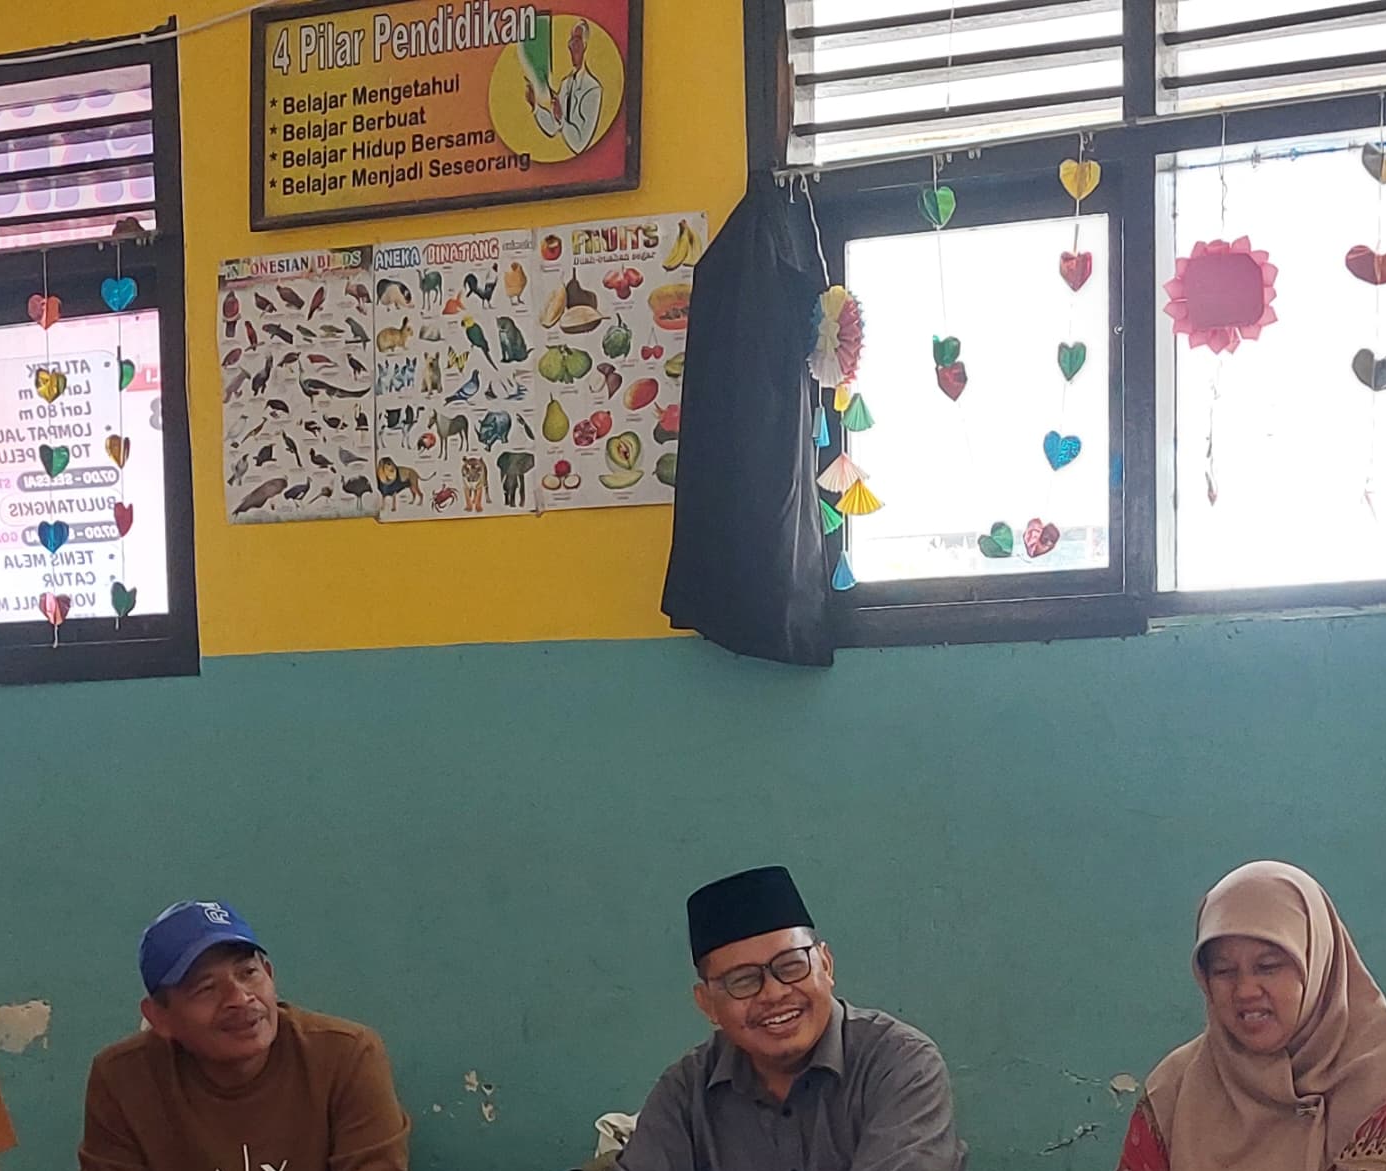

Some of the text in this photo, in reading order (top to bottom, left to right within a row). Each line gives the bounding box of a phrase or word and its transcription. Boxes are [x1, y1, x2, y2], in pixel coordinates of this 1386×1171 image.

[273, 0, 536, 75] 4 Pilar Pendidikan
[283, 74, 460, 115] Belajar Mengetahui
[283, 106, 427, 142] Belajar Berbuat
[283, 128, 495, 169] Belajar Hidup Bersama
[282, 153, 531, 195] Belajar Menjadi Seseorang
[375, 246, 421, 271] ANEKA
[424, 238, 500, 264] BINATANG
[572, 223, 659, 255] FRUITS
[225, 251, 361, 278] INONESIAN BIDS
